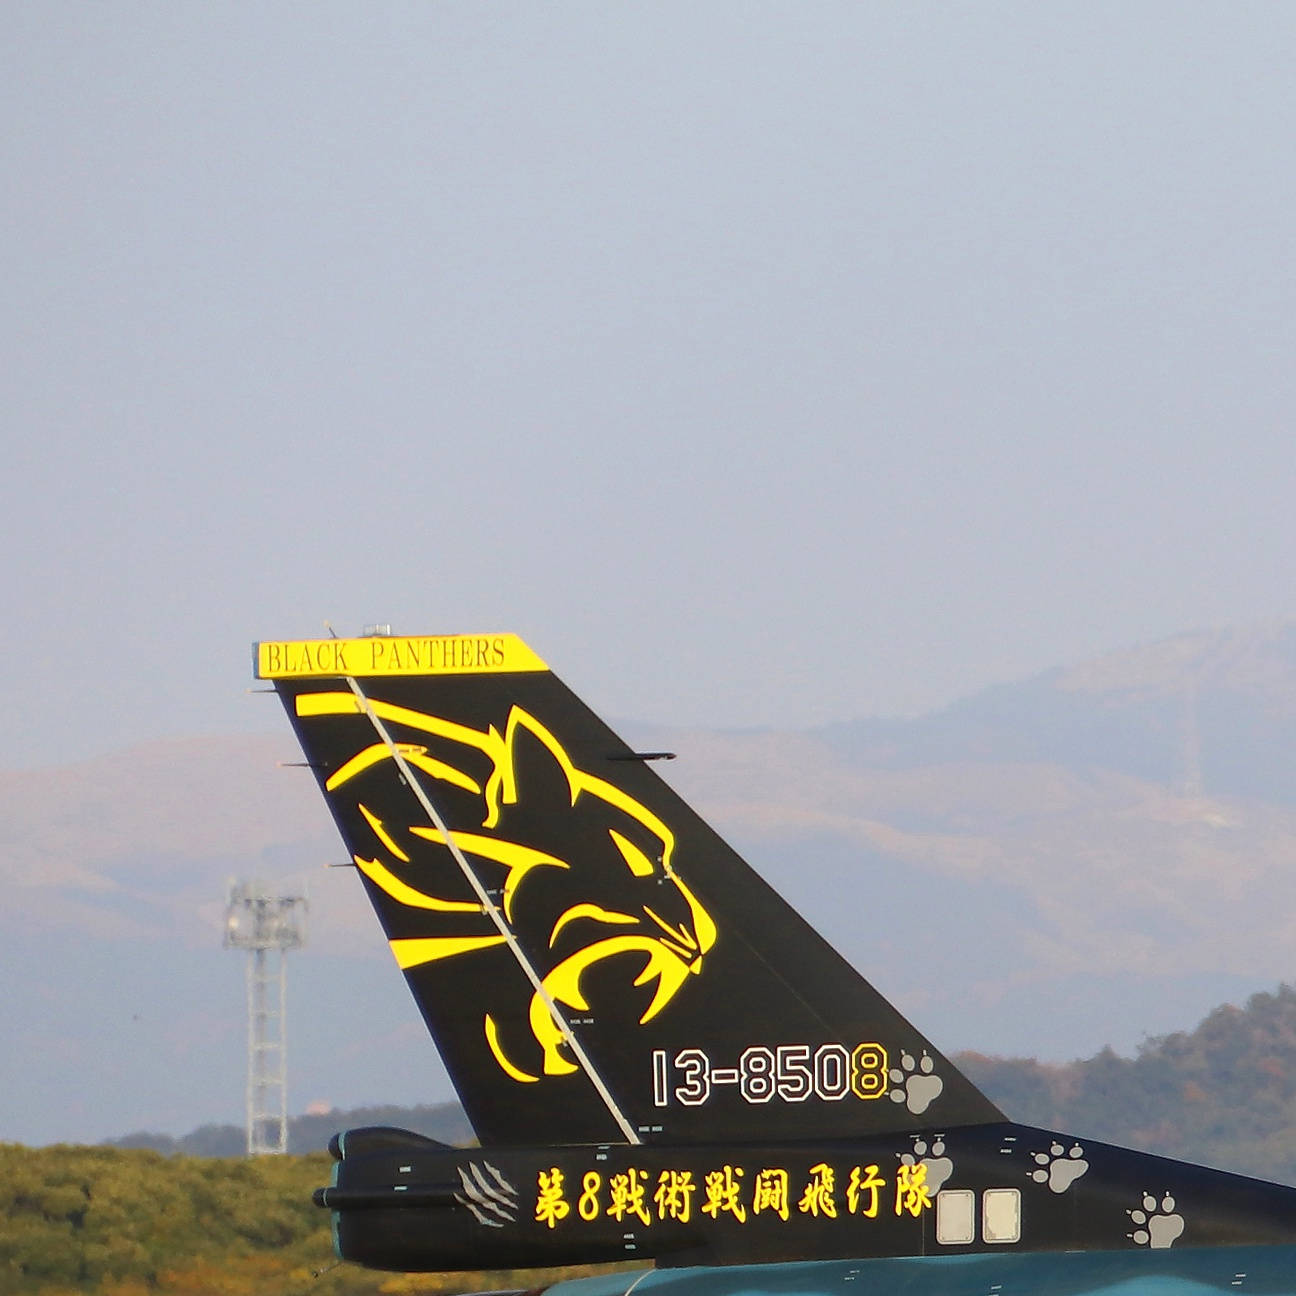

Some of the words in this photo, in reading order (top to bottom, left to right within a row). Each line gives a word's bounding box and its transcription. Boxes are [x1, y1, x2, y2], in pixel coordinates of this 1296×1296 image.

[267, 642, 348, 673] BLACK
[370, 638, 505, 670] PANTHERS
[652, 1042, 888, 1107] 13-8508
[534, 1162, 932, 1229] 第8戦術戦闘飛行隊
